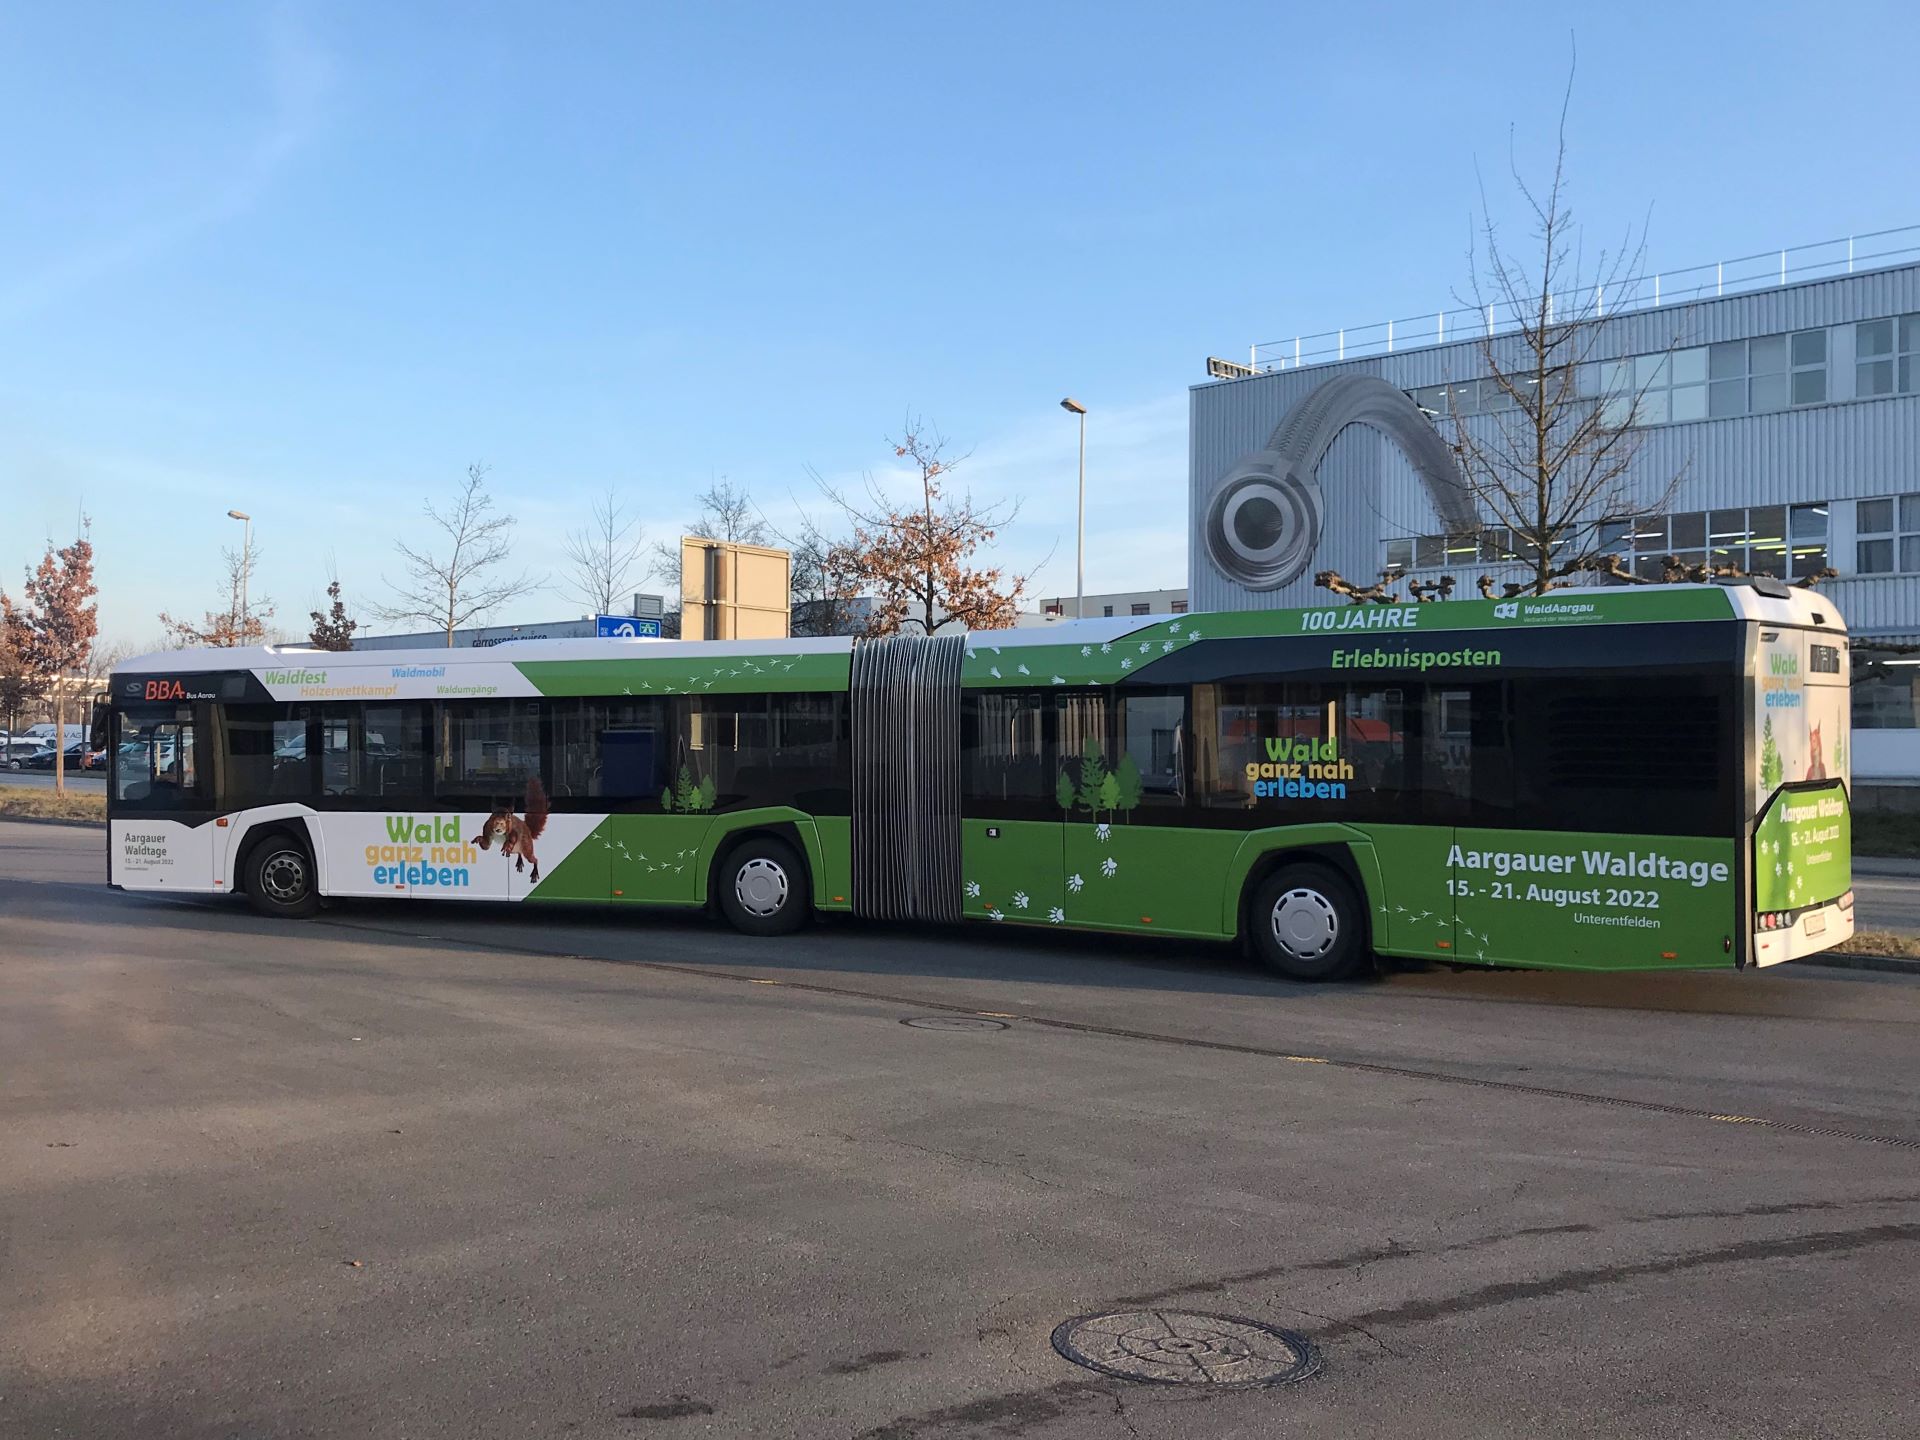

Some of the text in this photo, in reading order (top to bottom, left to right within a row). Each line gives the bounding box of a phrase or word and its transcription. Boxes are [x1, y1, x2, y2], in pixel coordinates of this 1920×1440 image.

[1301, 607, 1419, 631] 100 JAHRE
[1524, 603, 1595, 615] WaldAargau
[1331, 647, 1501, 672] Erlebnisposten
[1771, 653, 1798, 674] Wald
[265, 669, 328, 685] Waldfest
[391, 666, 446, 678] Waldmobil
[145, 680, 185, 700] BBA
[300, 684, 398, 697] Holzerwettkampf
[436, 685, 498, 696] Waldumgänge
[1765, 688, 1801, 707] erleben
[1265, 736, 1338, 762] Wald
[1245, 758, 1354, 781] ganz nah
[1253, 775, 1346, 799] erleben
[1780, 803, 1818, 824] Aargauer
[124, 832, 166, 845] Aargauer
[385, 815, 461, 843] Wald
[124, 845, 167, 858] Waldtage
[365, 839, 477, 866] ganz nah
[373, 860, 469, 886] erleben
[1445, 844, 1729, 887] Aargauer Waldtage
[1446, 879, 1475, 896] 15.
[1490, 882, 1522, 900] 21.
[1526, 884, 1600, 907] August
[1605, 889, 1660, 908] 2022
[1573, 912, 1661, 929] Unterentfelden
